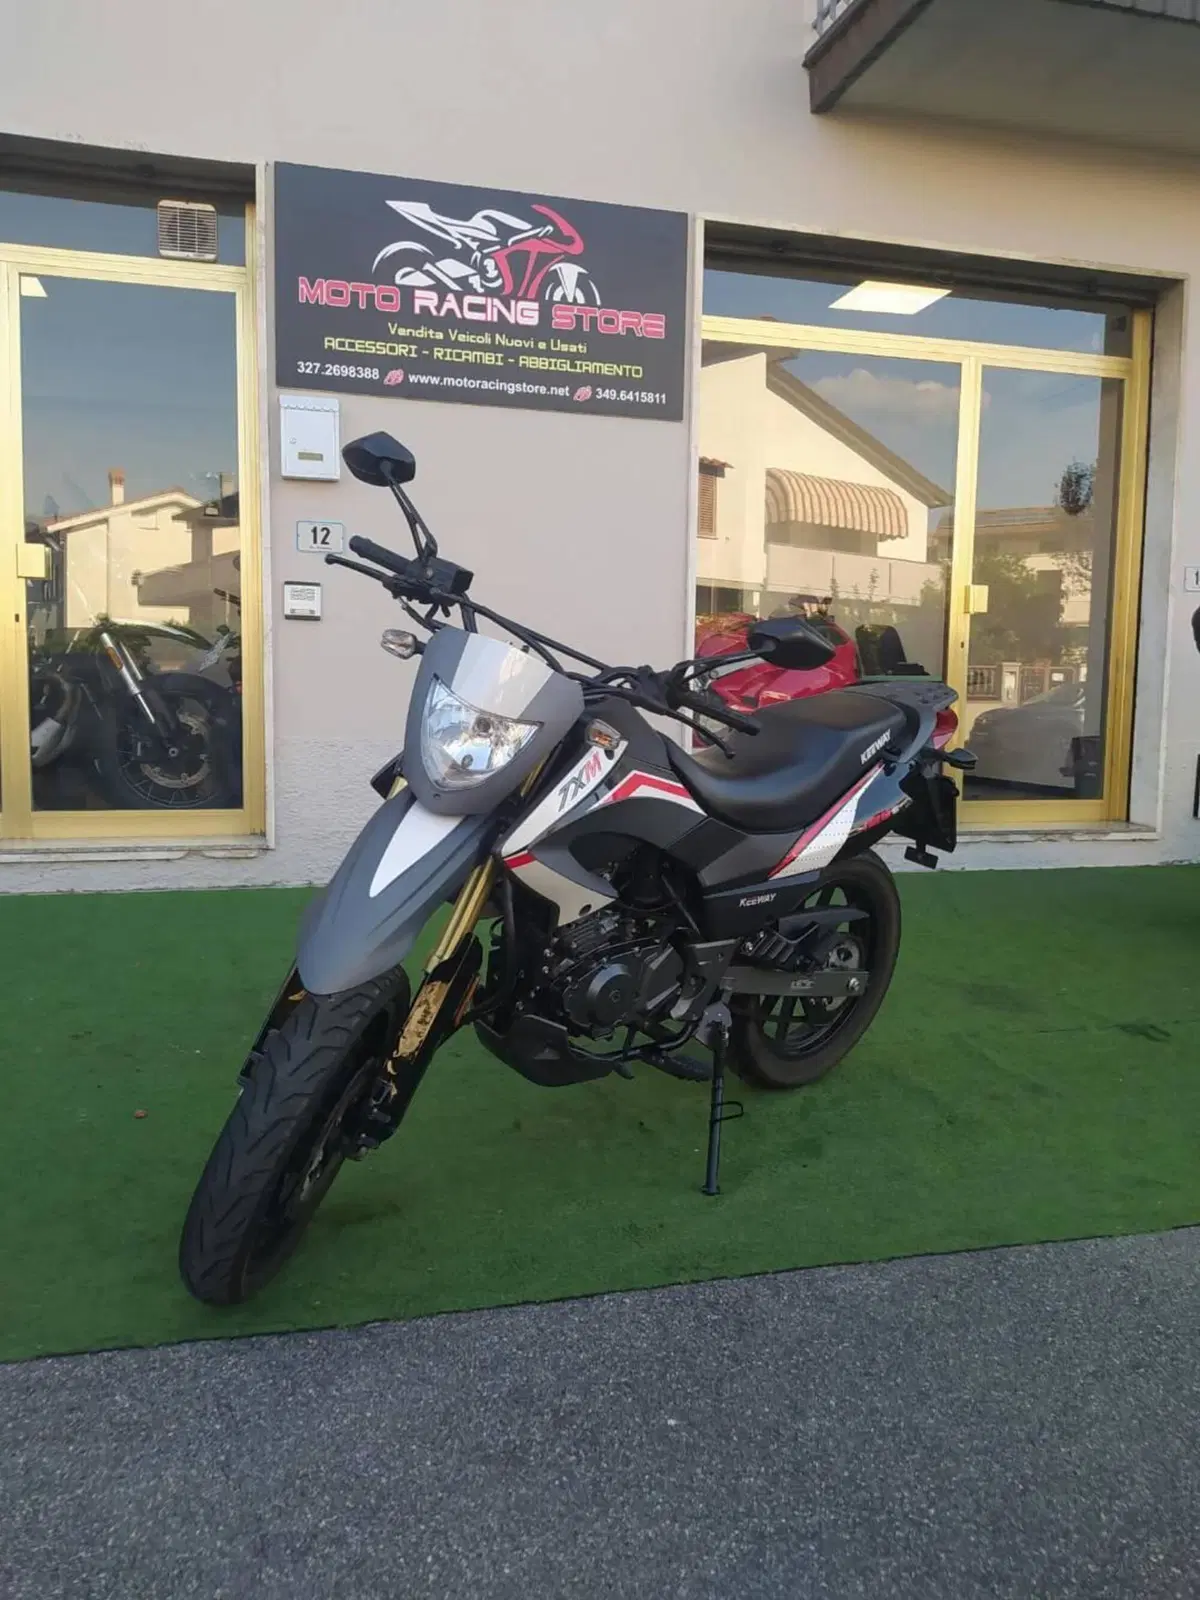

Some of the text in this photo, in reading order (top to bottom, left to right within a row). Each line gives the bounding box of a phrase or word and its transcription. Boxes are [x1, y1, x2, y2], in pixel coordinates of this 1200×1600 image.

[298, 276, 666, 339] MOTO RACING STORE
[324, 337, 418, 357] ACCESSORI
[433, 347, 504, 366] RICAMBI
[519, 355, 644, 378] ABBIGLIAMENTO
[388, 322, 588, 354] Vendita Veicoli Nuovi e Usati
[296, 361, 666, 404] 327.2698388 www.motoracingstore.net 349.6415811
[311, 526, 331, 545] 12
[860, 728, 891, 765] KEEWAY
